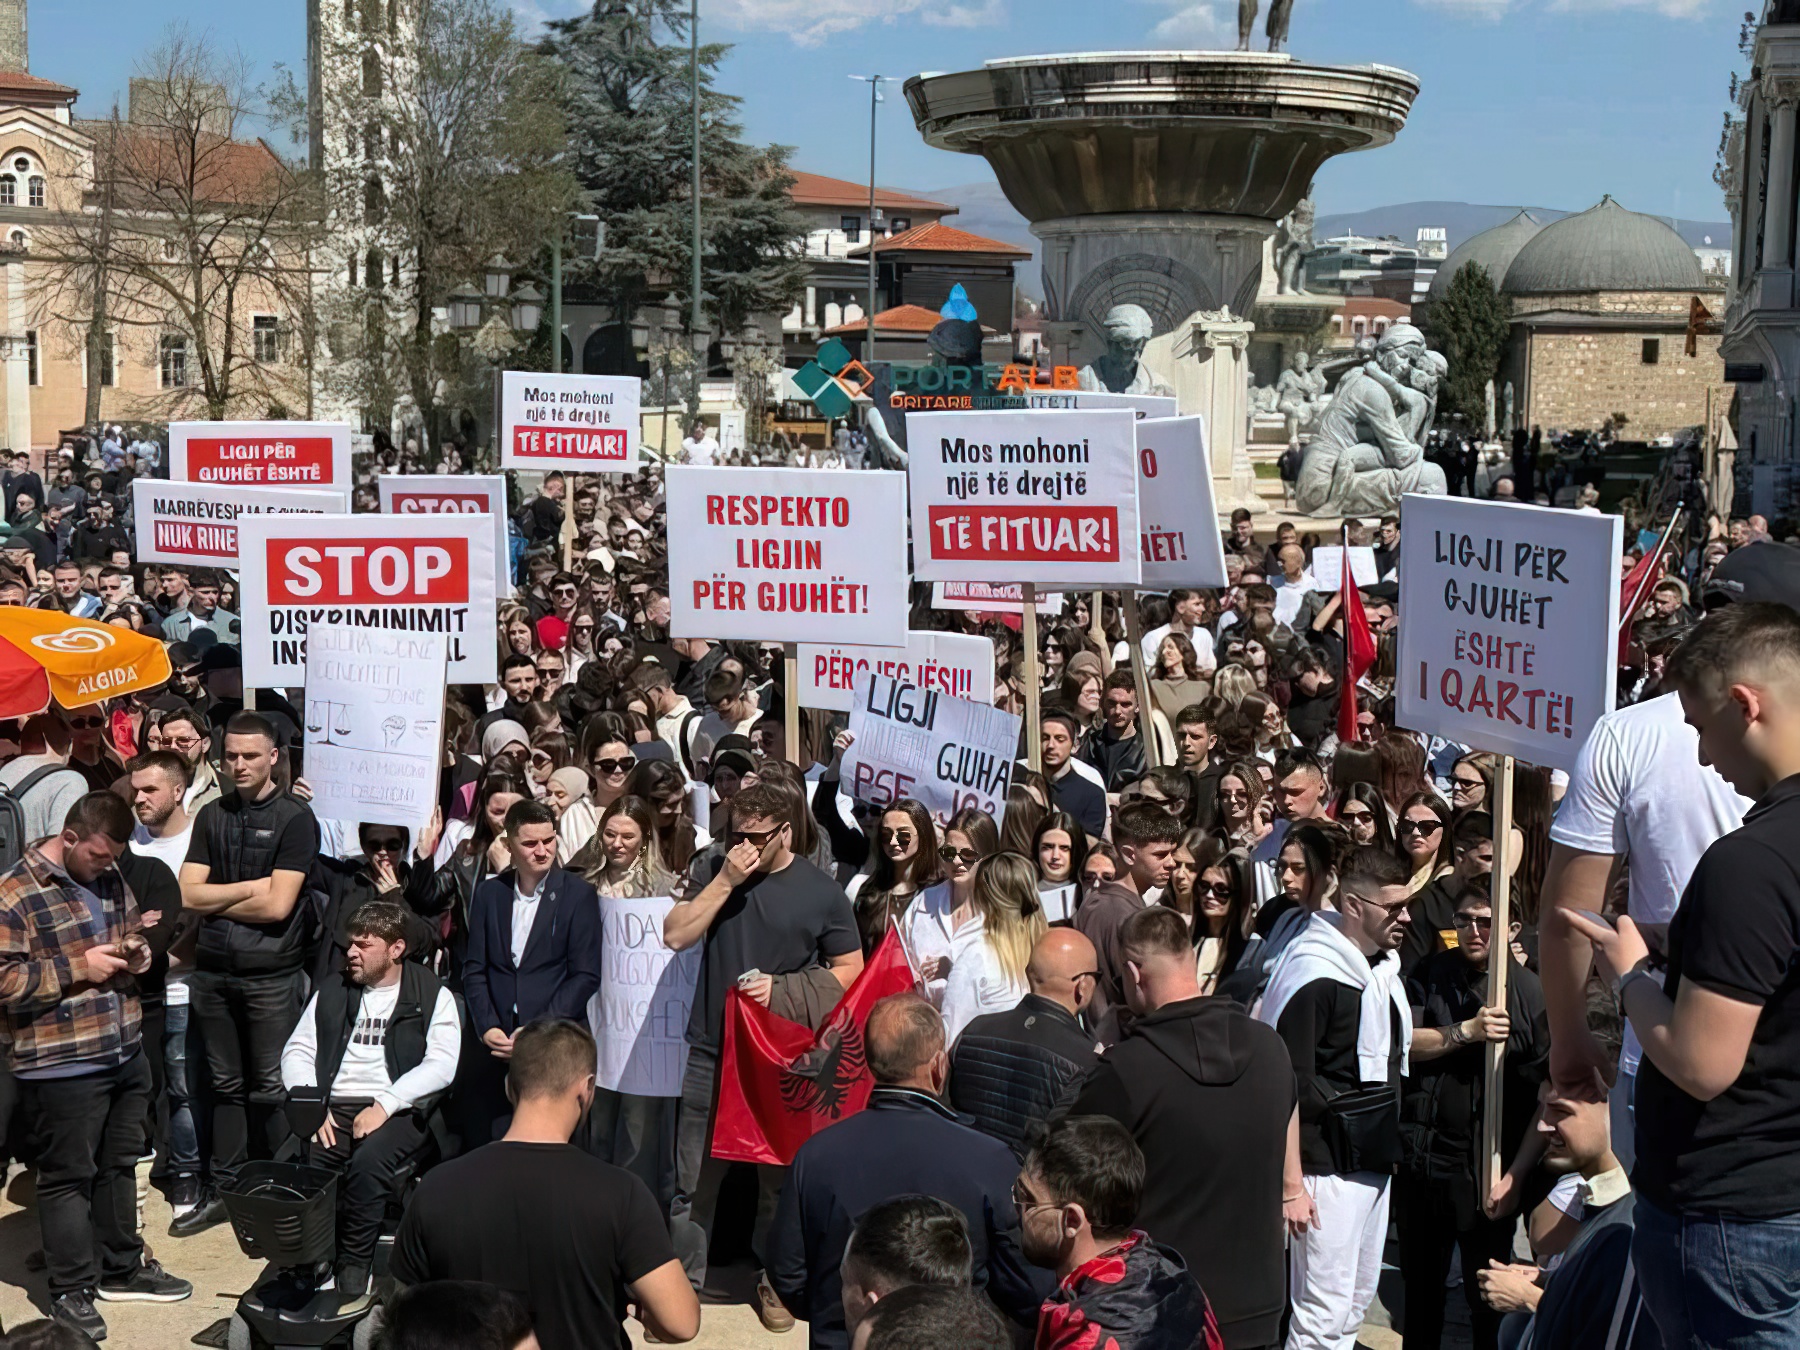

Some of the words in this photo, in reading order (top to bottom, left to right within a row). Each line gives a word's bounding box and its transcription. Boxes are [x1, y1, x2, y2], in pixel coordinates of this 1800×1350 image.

[263, 442, 295, 459] PËR
[545, 433, 623, 456] FITUAR!
[941, 437, 993, 463] Mos
[1001, 437, 1089, 463] mohoni
[267, 463, 321, 481] ËSHTË
[946, 471, 979, 500] një
[987, 470, 1008, 496] të
[1016, 470, 1087, 500] drejtë
[707, 494, 849, 527] RESPEKTO
[157, 523, 194, 549] NUK
[935, 515, 972, 550] TË
[981, 517, 1111, 552] FITUAR!
[284, 546, 452, 596] STOP
[736, 539, 822, 570] LIGJIN
[1435, 530, 1503, 573] LIGJI
[1514, 542, 1569, 583] PËR
[693, 573, 746, 611] PËR
[757, 576, 869, 613] GJUHËT!
[1444, 578, 1553, 629] GJUHËT
[1454, 629, 1535, 675] ËSHTË
[77, 666, 138, 696] ALGIDA
[867, 673, 938, 731] LIGJI
[1420, 661, 1428, 700] I
[1440, 668, 1573, 739] QARTË!
[854, 761, 916, 804] PSE
[936, 742, 1010, 800] GJUHA
